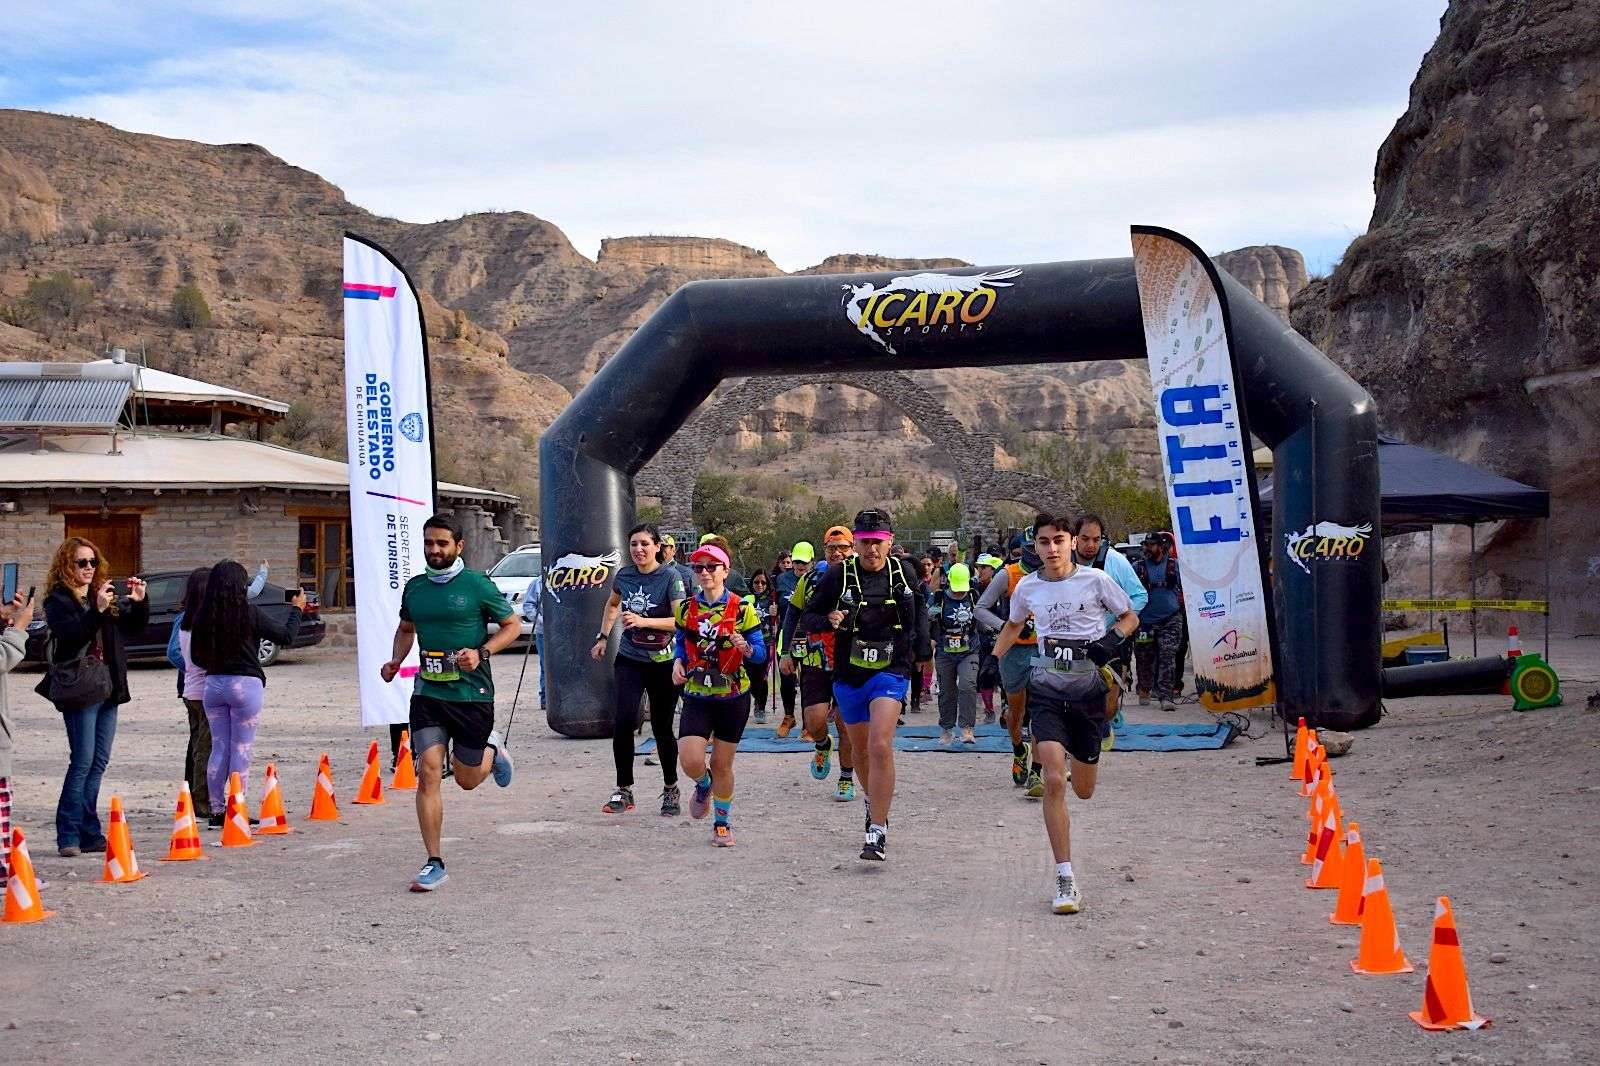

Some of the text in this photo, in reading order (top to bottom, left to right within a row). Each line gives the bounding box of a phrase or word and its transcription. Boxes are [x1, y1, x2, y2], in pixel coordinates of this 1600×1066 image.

[858, 287, 997, 328] ICARO
[886, 322, 983, 336] SPORTS
[355, 386, 366, 467] DE CHIHUAHUA
[365, 373, 382, 480] DEL ESTADO
[379, 381, 395, 472] GOBIERNO
[1160, 384, 1241, 545] FITA
[386, 514, 399, 590] DE TURISMO
[1294, 535, 1364, 558] ICARO
[546, 564, 609, 589] ICARO
[862, 647, 879, 663] 19
[948, 639, 961, 648] 58
[1053, 646, 1073, 662] 20
[425, 657, 443, 674] 55
[703, 674, 713, 687] 4
